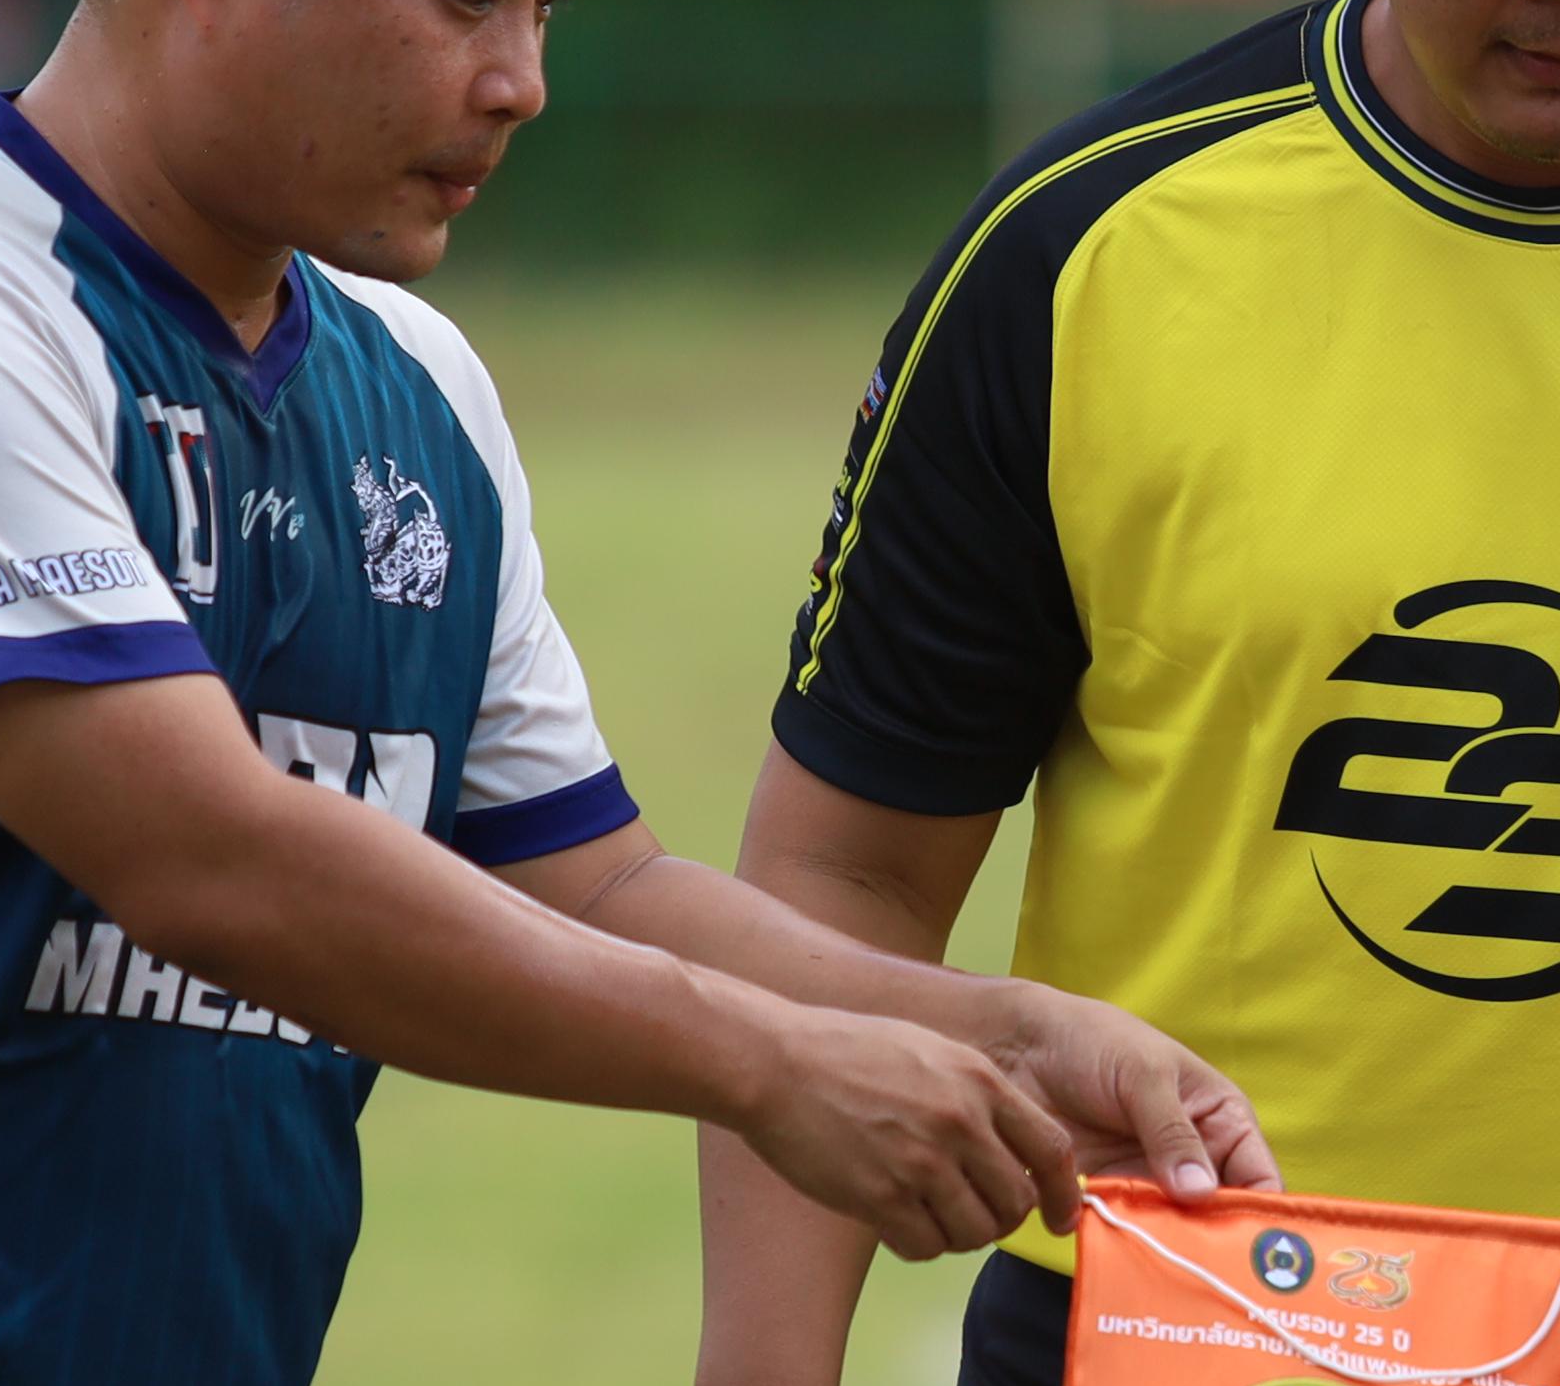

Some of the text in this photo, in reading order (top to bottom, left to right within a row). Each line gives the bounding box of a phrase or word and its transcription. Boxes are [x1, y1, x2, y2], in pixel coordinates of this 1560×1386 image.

[9, 547, 148, 599] MAESOT
[1353, 1324, 1384, 1347] 25
[1392, 1326, 1412, 1354] ปี
